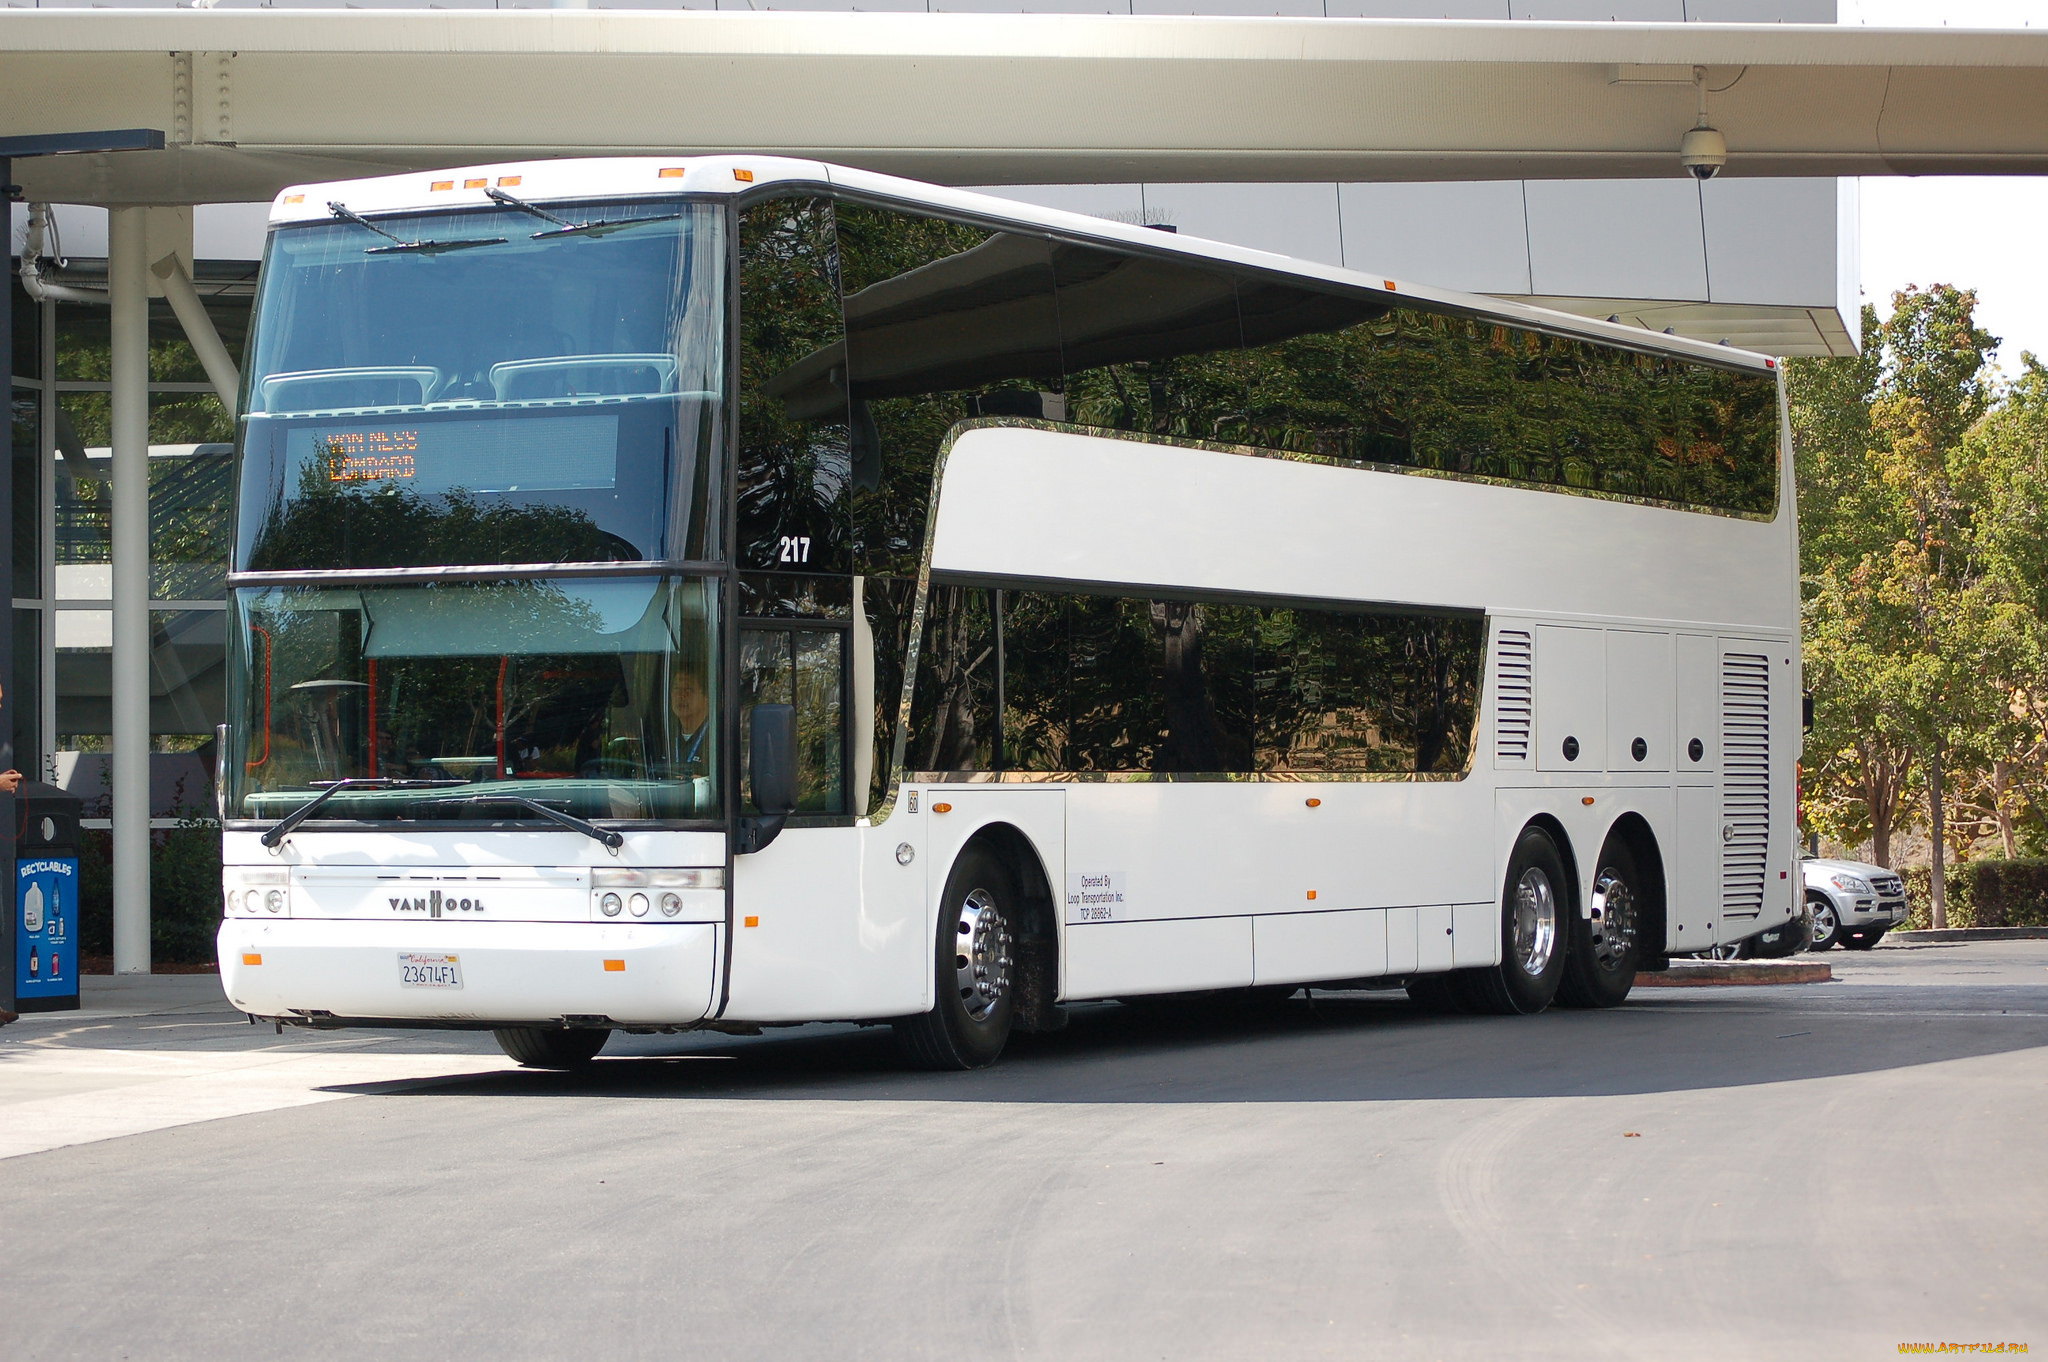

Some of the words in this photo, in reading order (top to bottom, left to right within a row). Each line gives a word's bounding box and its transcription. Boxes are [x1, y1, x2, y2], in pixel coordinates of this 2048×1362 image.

[328, 434, 364, 453] VAN
[330, 456, 415, 480] LOMBARD
[780, 536, 810, 563] 217
[20, 861, 72, 878] RECYCLABLES
[1081, 875, 1103, 889] Operated
[1104, 875, 1111, 889] By
[1067, 892, 1080, 906] Loop
[1081, 891, 1114, 905] Transportation
[1115, 890, 1124, 902] Inc.
[1080, 908, 1090, 920] TCP
[410, 953, 446, 965] California
[403, 966, 458, 984] 23674F1
